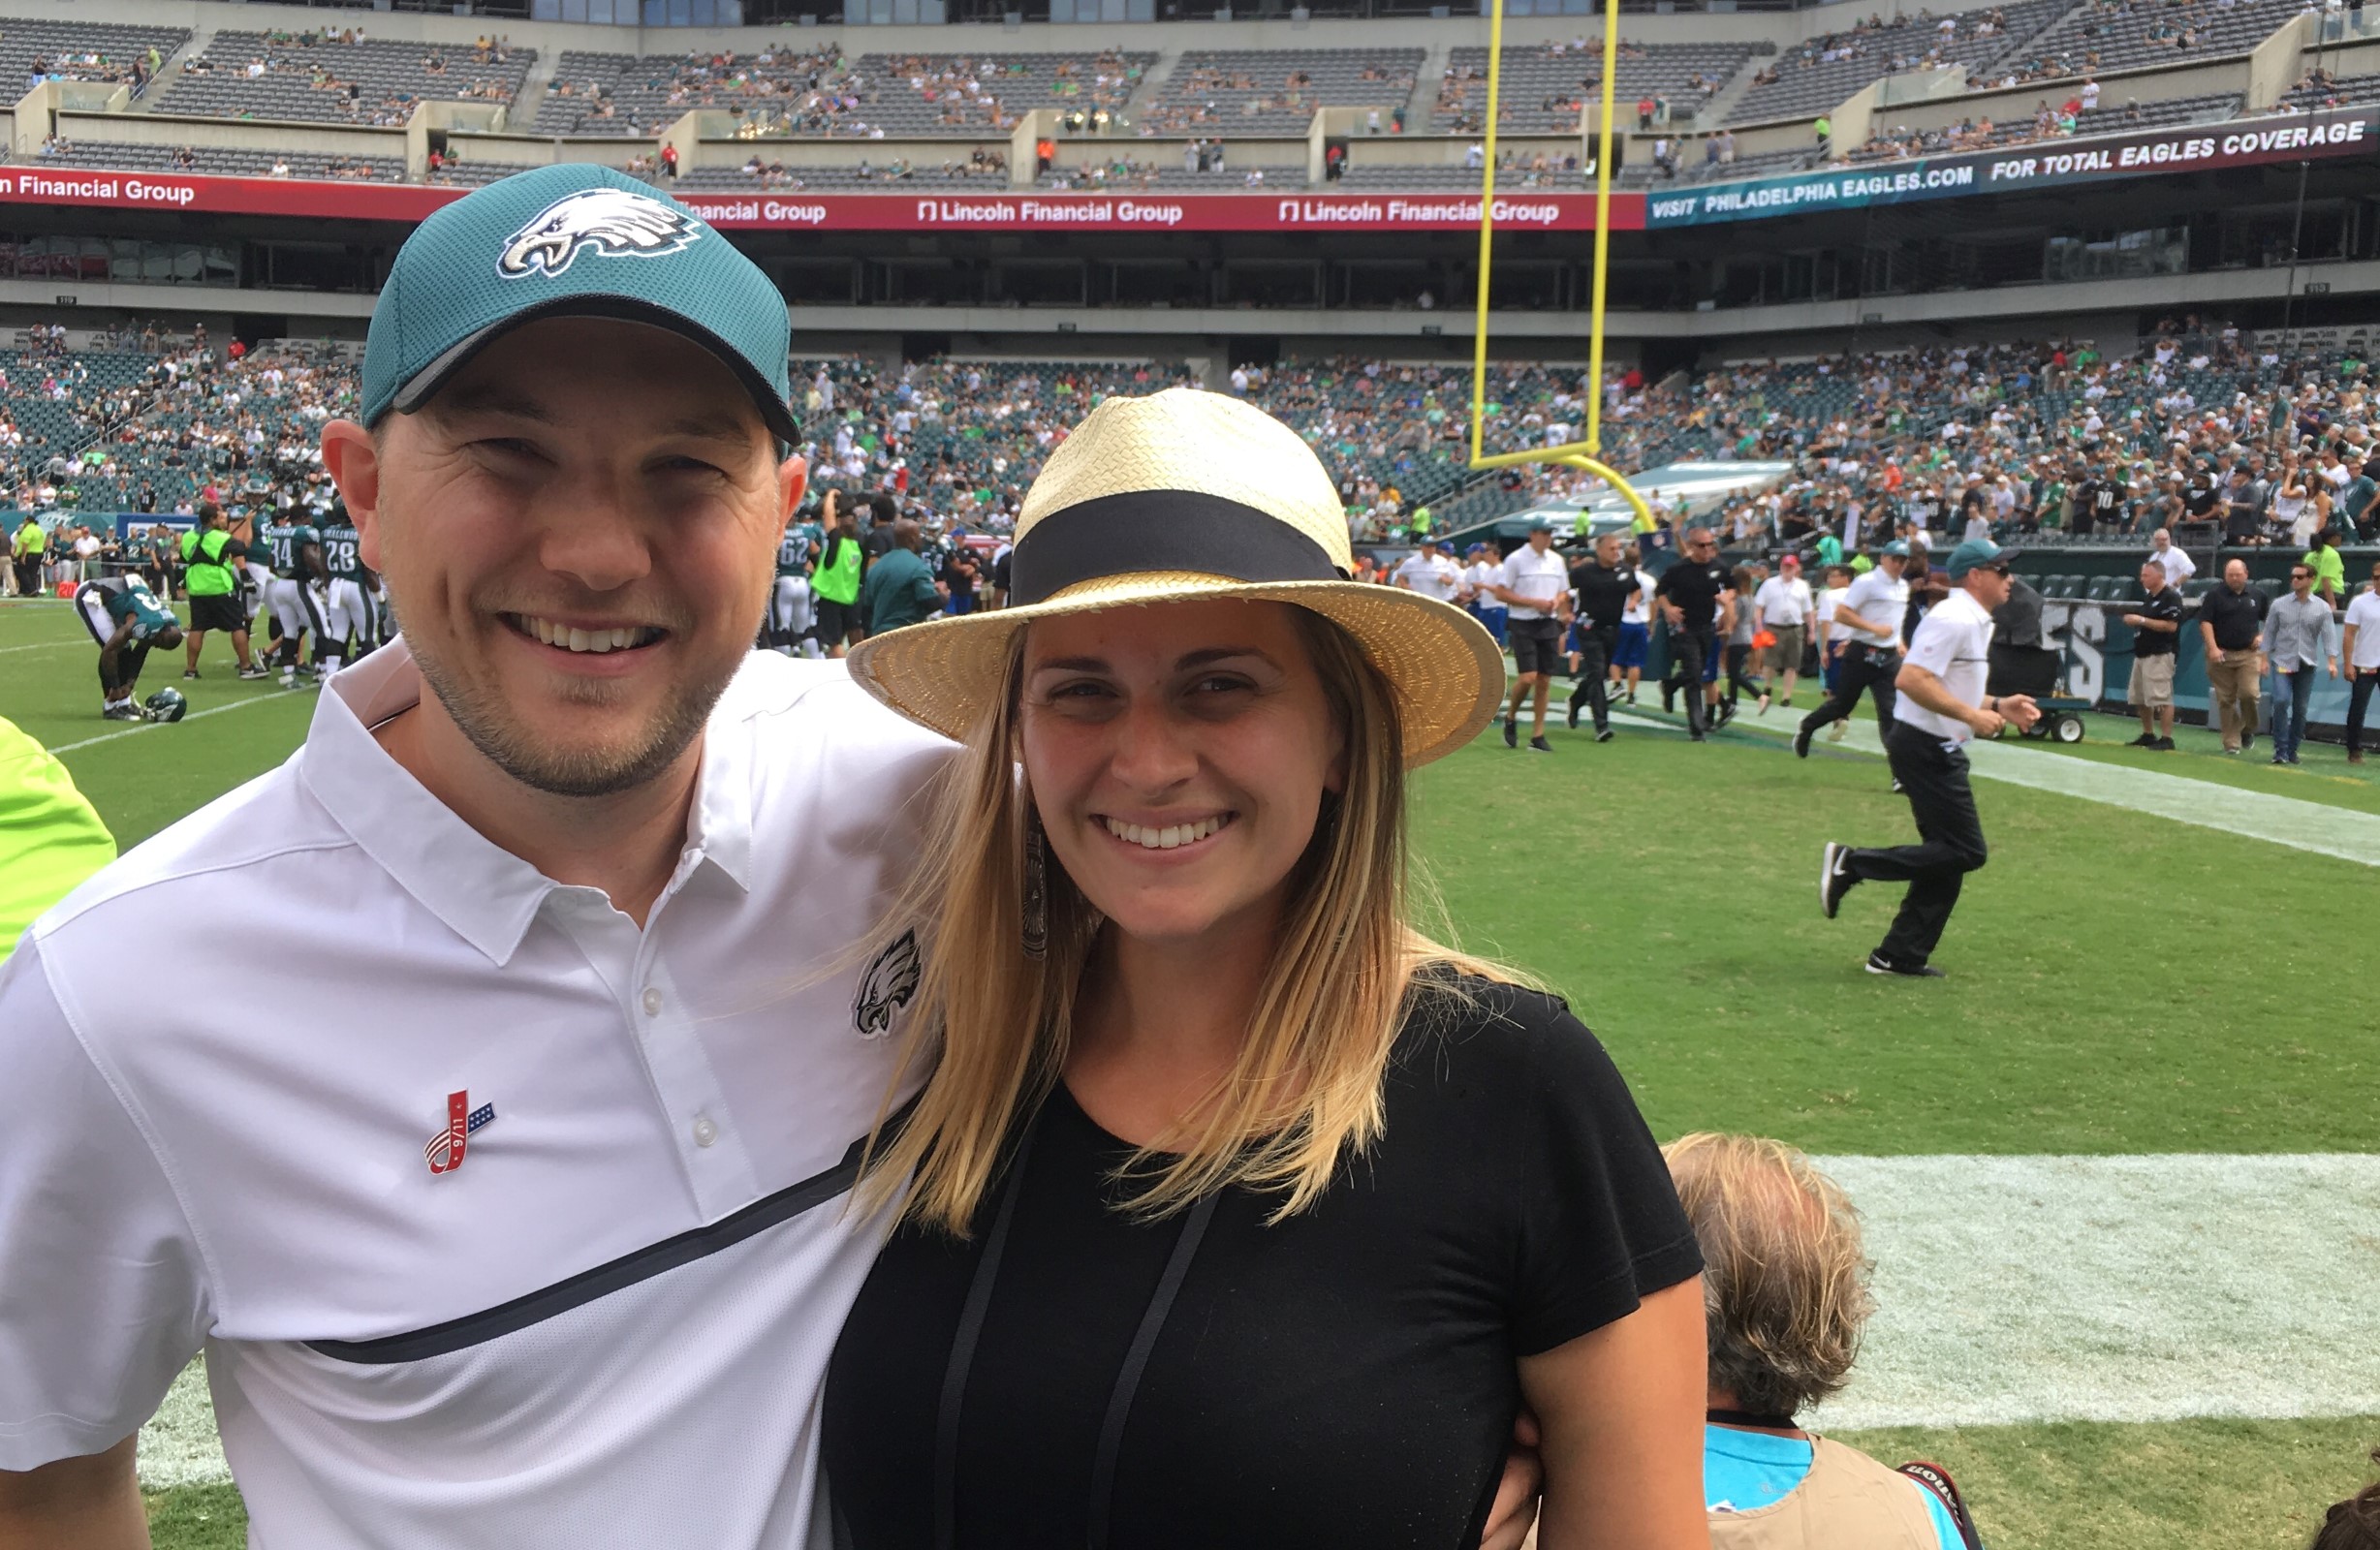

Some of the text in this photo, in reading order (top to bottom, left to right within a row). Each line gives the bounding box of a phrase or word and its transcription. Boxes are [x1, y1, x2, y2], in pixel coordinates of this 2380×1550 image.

[1652, 120, 2366, 219] VISIT PHILADELPHIA EAGLES.COM FOR TOTAL EAGLES COVERAGE
[19, 175, 118, 198] Financial
[125, 180, 195, 205] Group
[764, 202, 827, 225] Group
[941, 201, 1183, 226] Lincoln Financial Group
[1303, 200, 1559, 225] Lincoln Financial Group
[326, 540, 356, 573] 28
[780, 537, 809, 566] 62
[452, 1118, 464, 1148] 9/11
